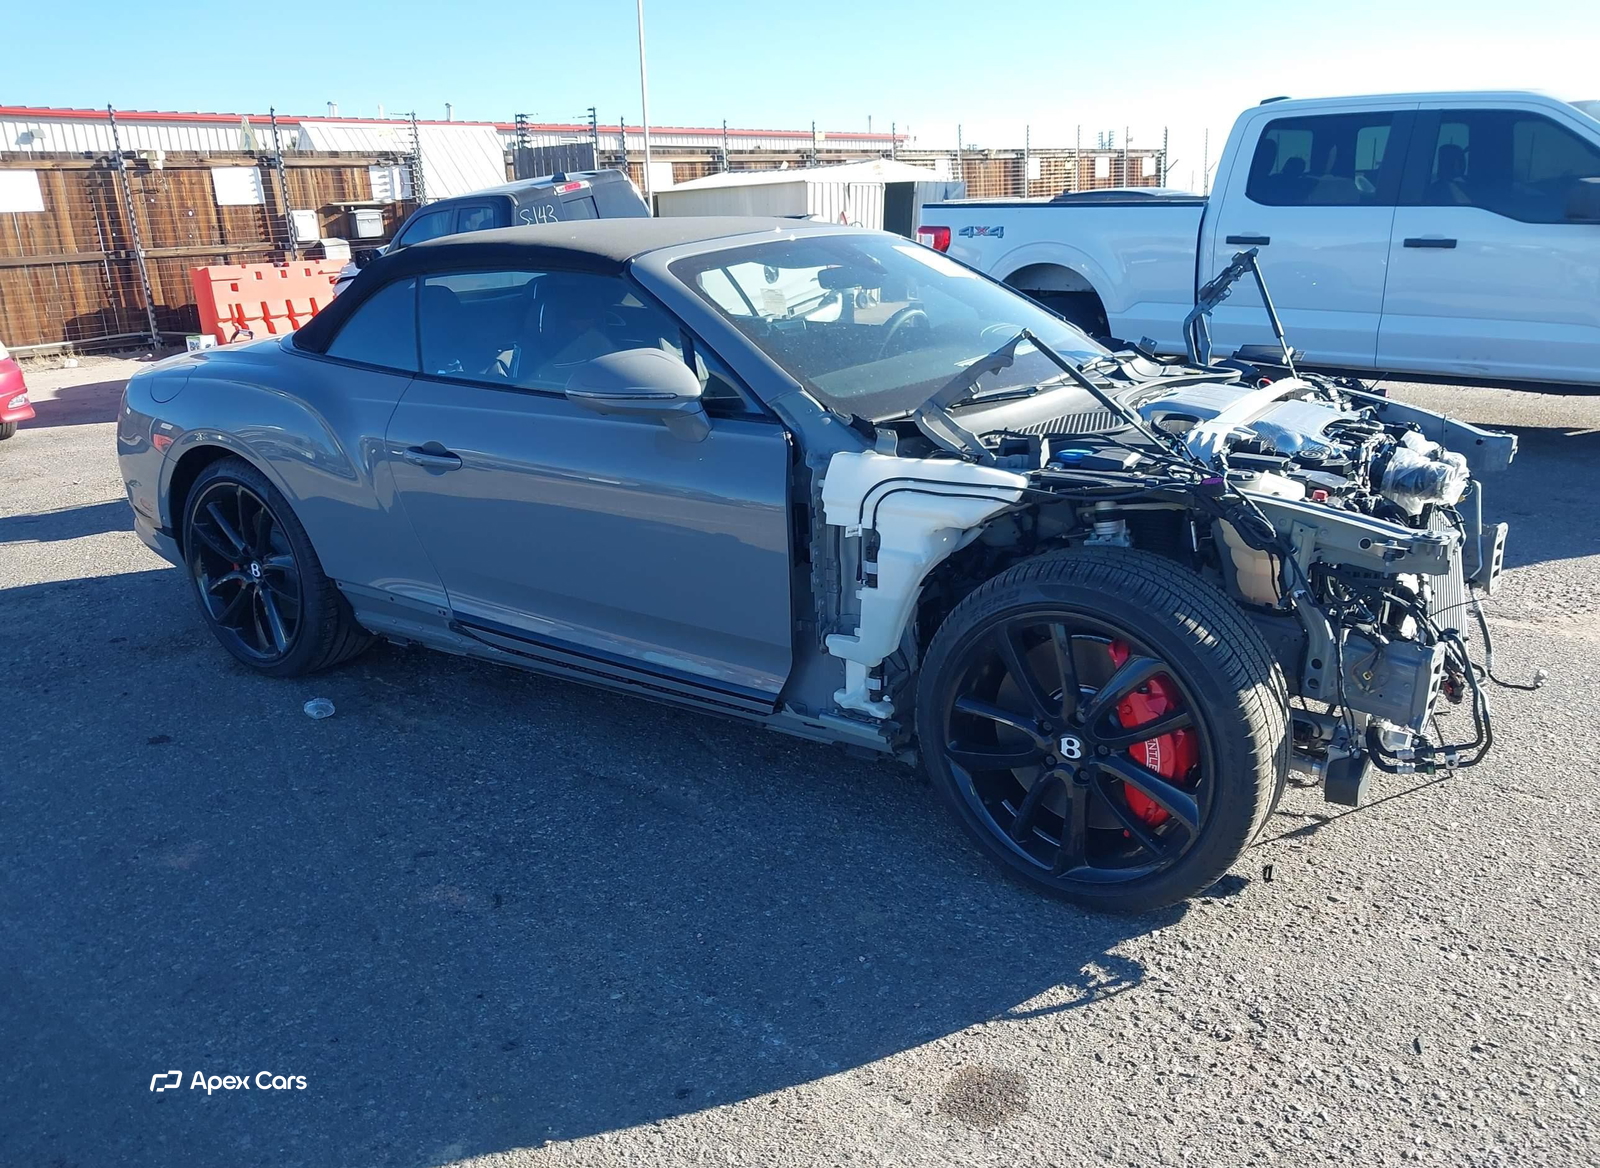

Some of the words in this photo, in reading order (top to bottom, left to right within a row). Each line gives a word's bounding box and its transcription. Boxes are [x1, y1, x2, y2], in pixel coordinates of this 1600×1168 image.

[250, 563, 261, 578] B
[1060, 737, 1082, 759] B
[1147, 738, 1159, 772] NTLE
